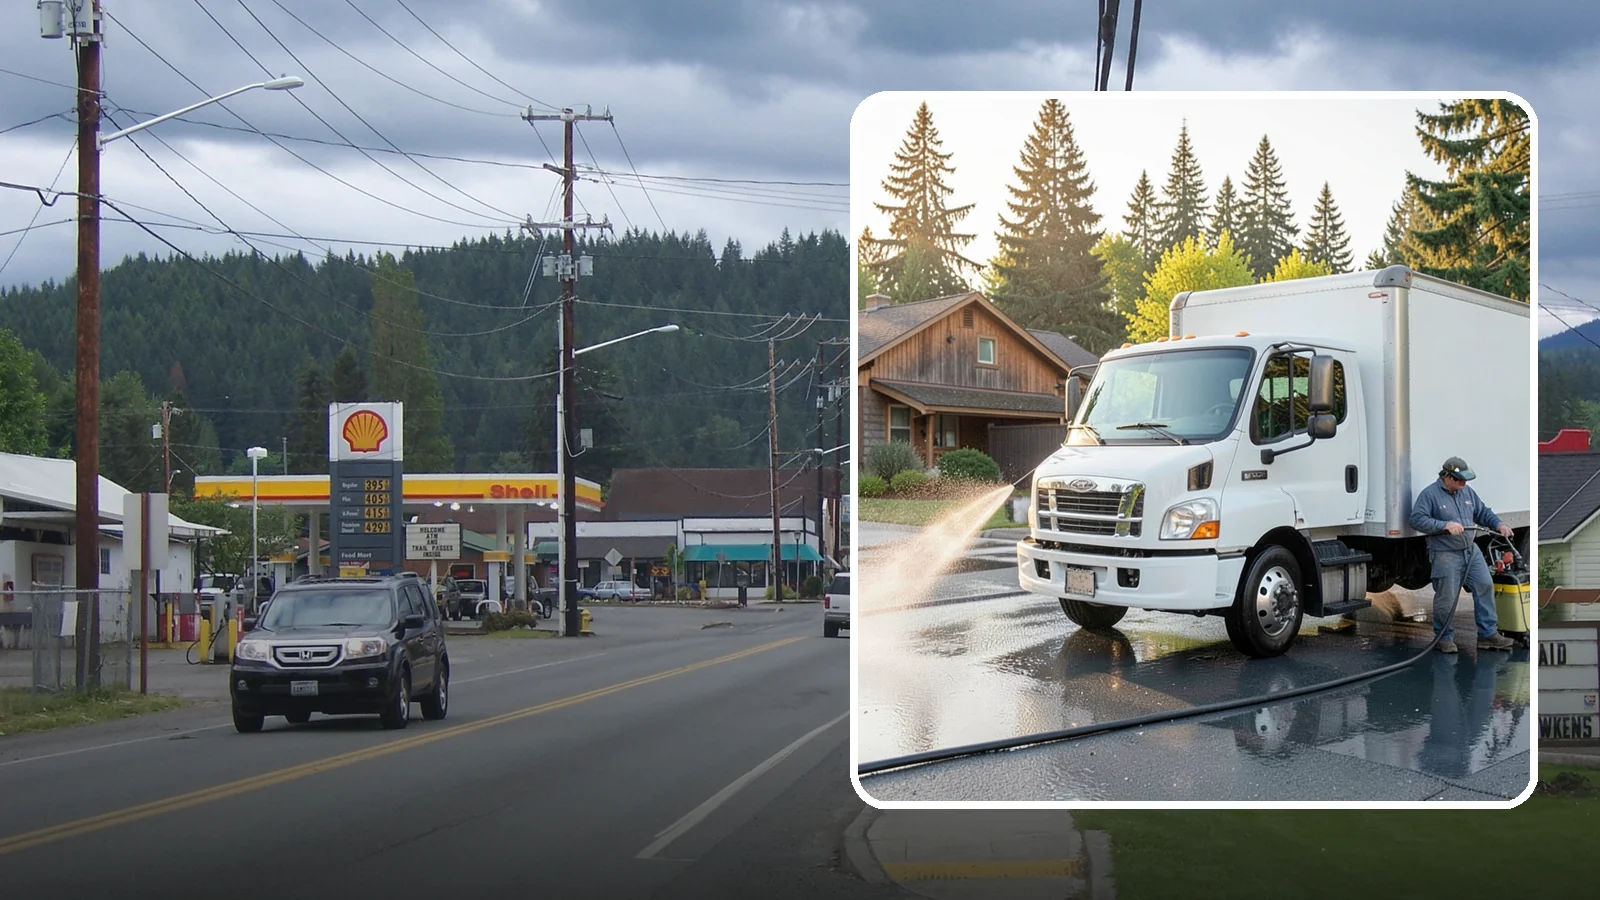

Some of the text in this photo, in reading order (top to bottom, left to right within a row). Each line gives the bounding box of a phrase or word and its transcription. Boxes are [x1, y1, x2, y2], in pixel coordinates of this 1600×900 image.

[366, 480, 383, 490] 395
[490, 484, 547, 499] Shell
[366, 494, 383, 504] 405
[366, 508, 383, 518] 415
[366, 522, 383, 533] 429
